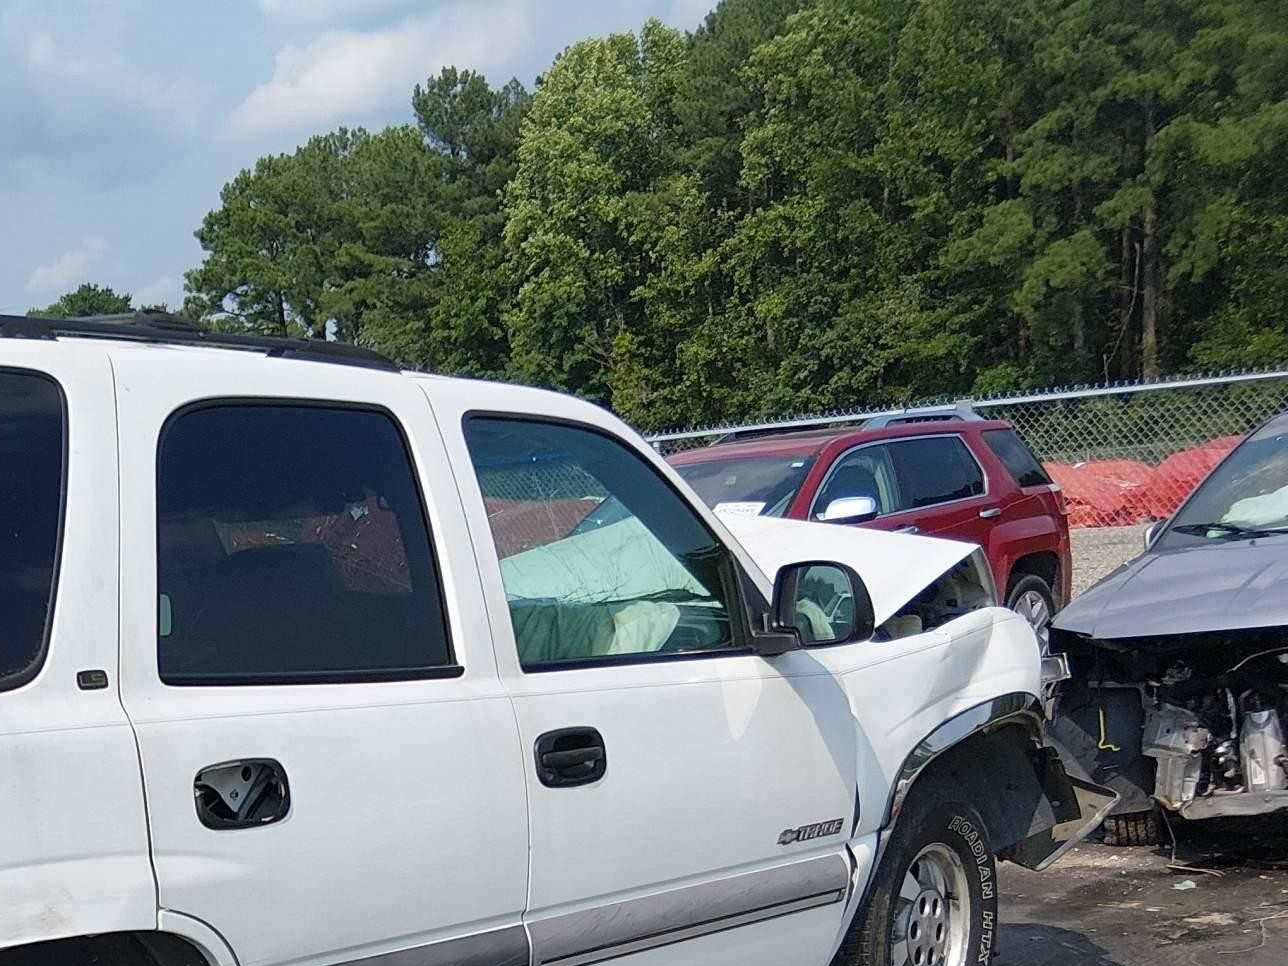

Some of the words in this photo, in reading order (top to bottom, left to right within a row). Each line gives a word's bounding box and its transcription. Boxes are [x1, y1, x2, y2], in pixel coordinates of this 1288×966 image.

[797, 817, 844, 842] TAHOE
[949, 815, 993, 899] ROADIAN
[978, 911, 993, 966] HTX
